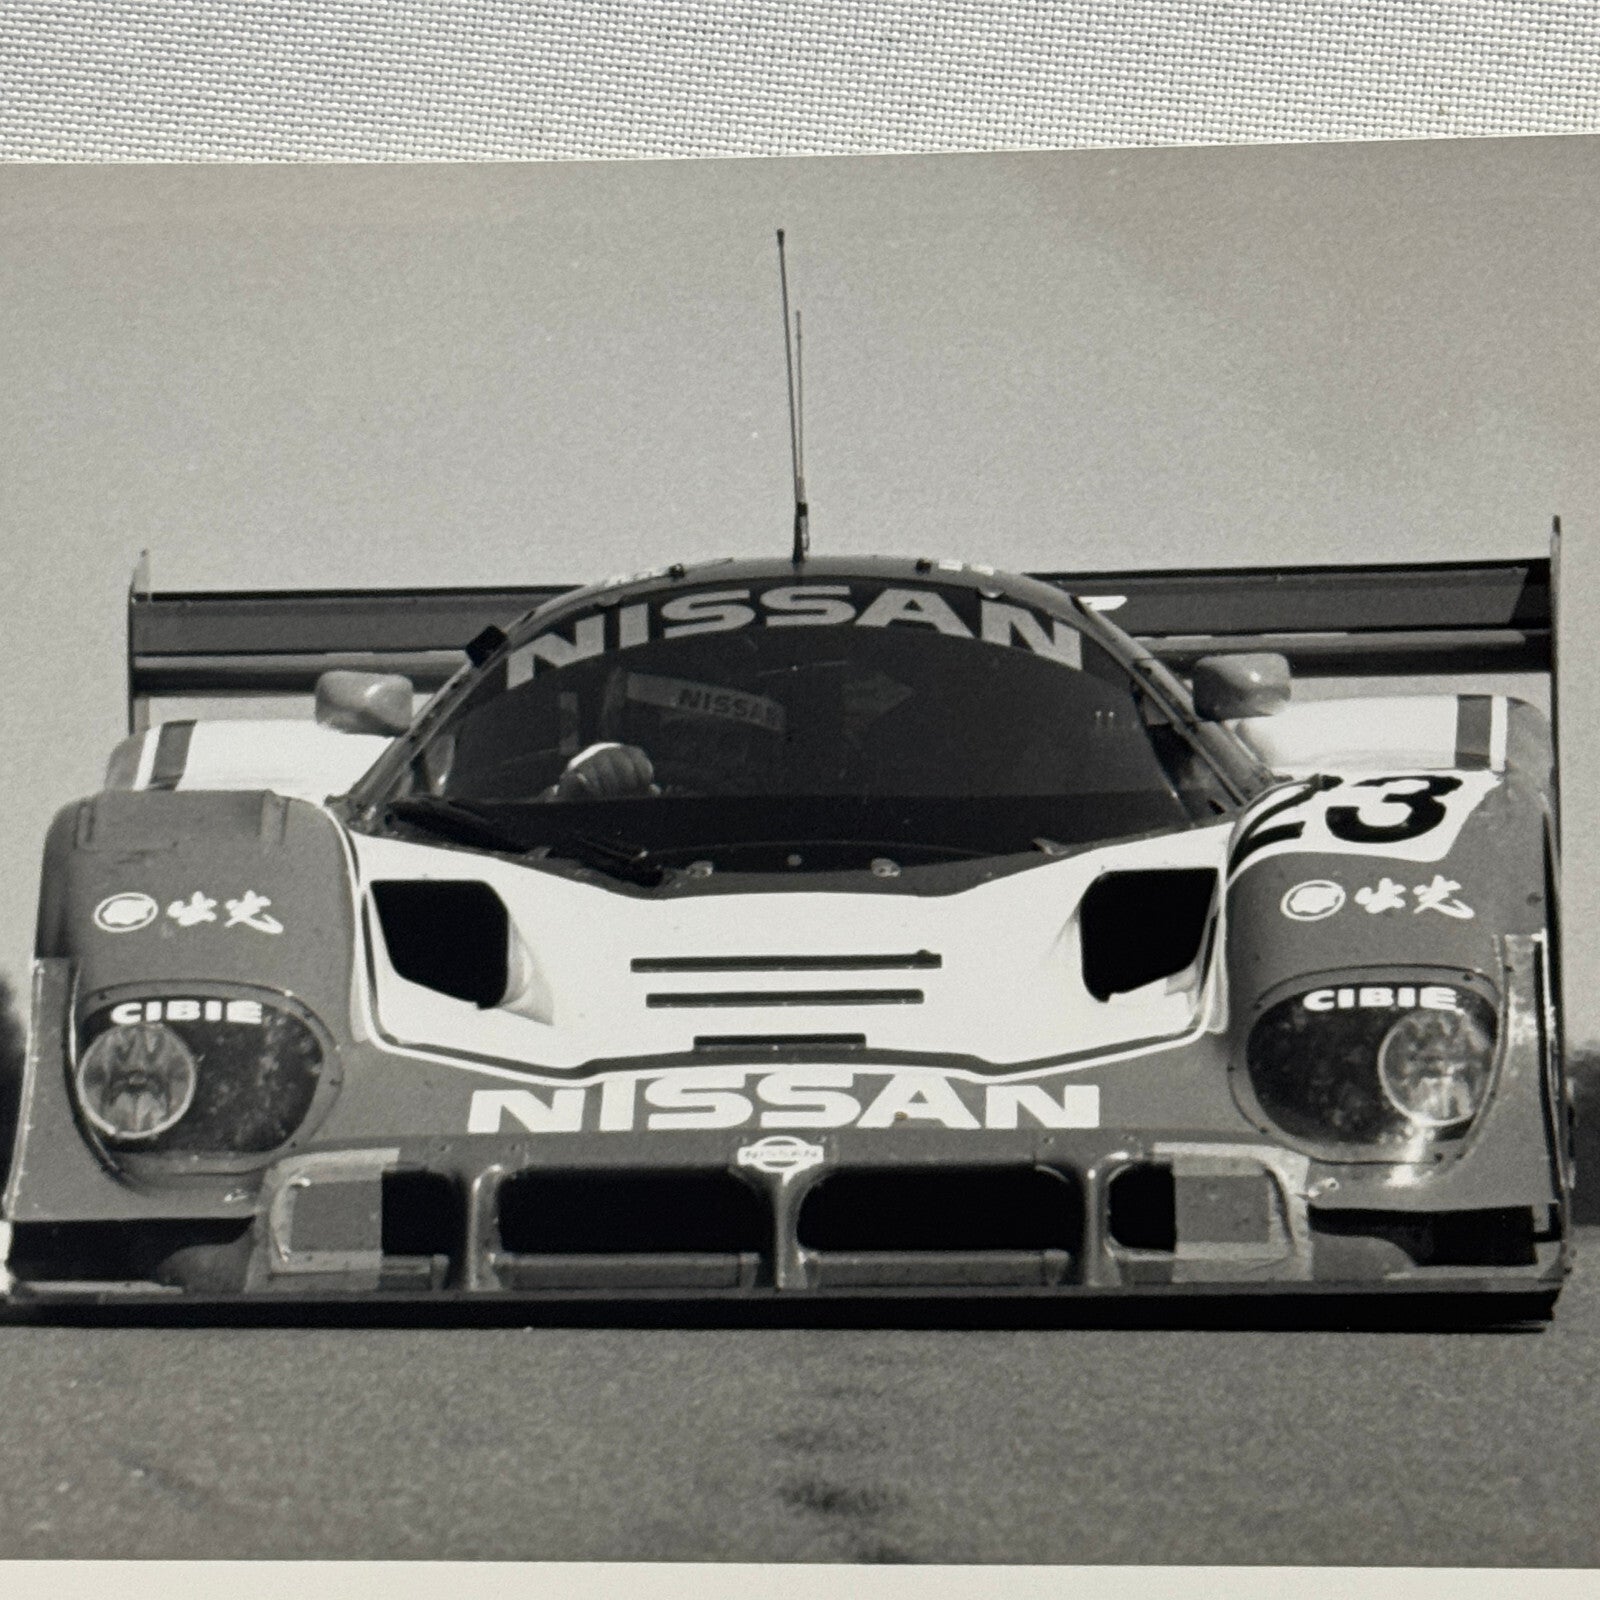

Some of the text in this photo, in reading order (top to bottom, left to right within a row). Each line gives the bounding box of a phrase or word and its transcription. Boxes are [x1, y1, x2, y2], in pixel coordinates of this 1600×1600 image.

[507, 585, 1082, 689] NISSAN
[1227, 775, 1462, 880] 23
[111, 1001, 263, 1025] CIBIE
[1303, 987, 1459, 1012] CIBIE
[467, 1071, 1100, 1134] NISSAN
